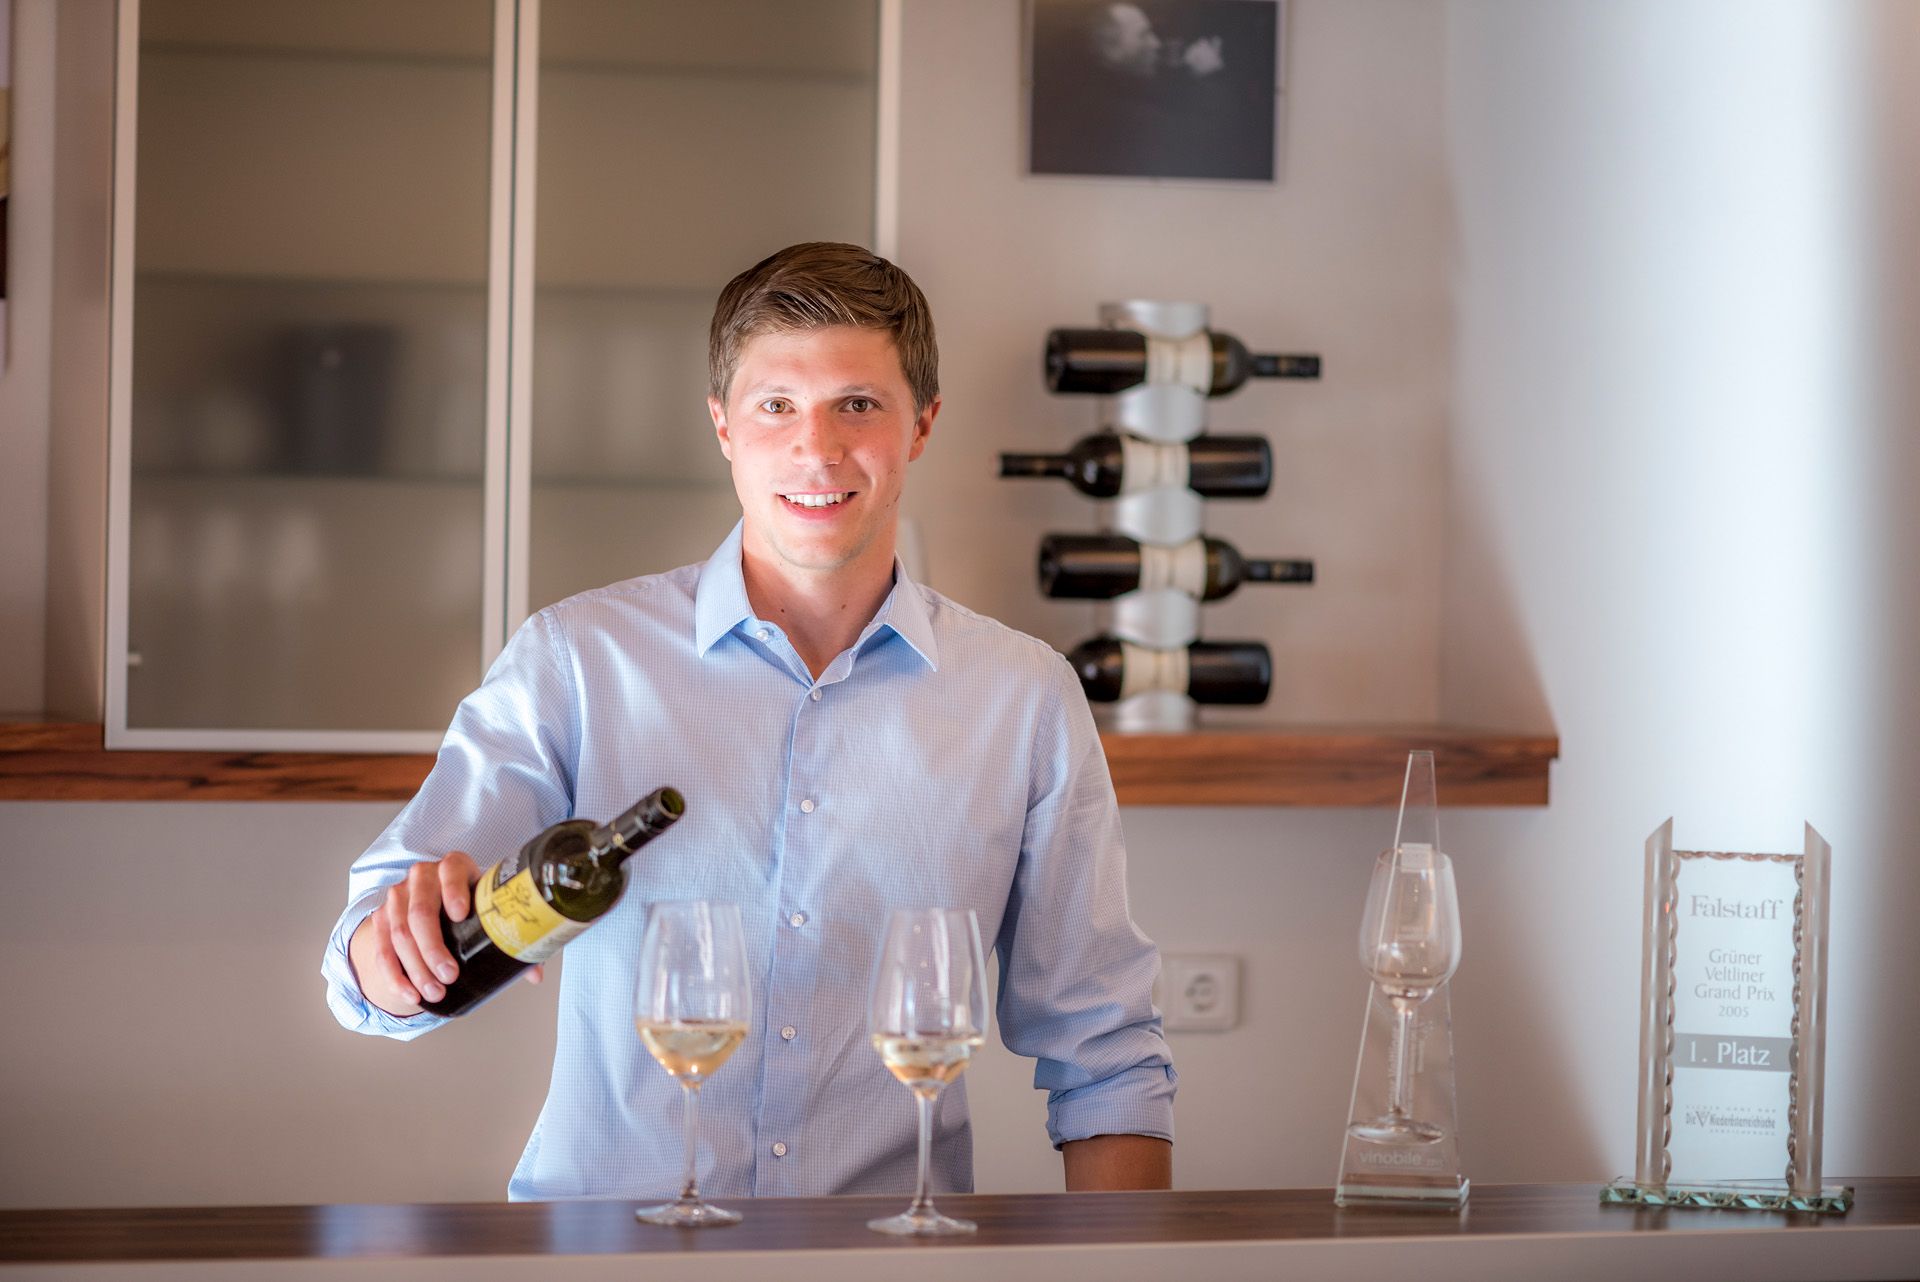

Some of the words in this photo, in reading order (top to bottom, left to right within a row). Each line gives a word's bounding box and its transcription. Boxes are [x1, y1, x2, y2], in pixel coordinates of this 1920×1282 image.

[1689, 894, 1784, 920] Falstaff
[1708, 948, 1762, 965] Grüner
[1704, 966, 1765, 983] Veltliner
[1694, 983, 1741, 1000] Grand
[1747, 985, 1775, 1002] Prix
[1718, 1005, 1749, 1018] 2005
[1690, 1040, 1708, 1063] 1.
[1717, 1041, 1771, 1066] Platz
[1359, 1148, 1422, 1166] vinobile
